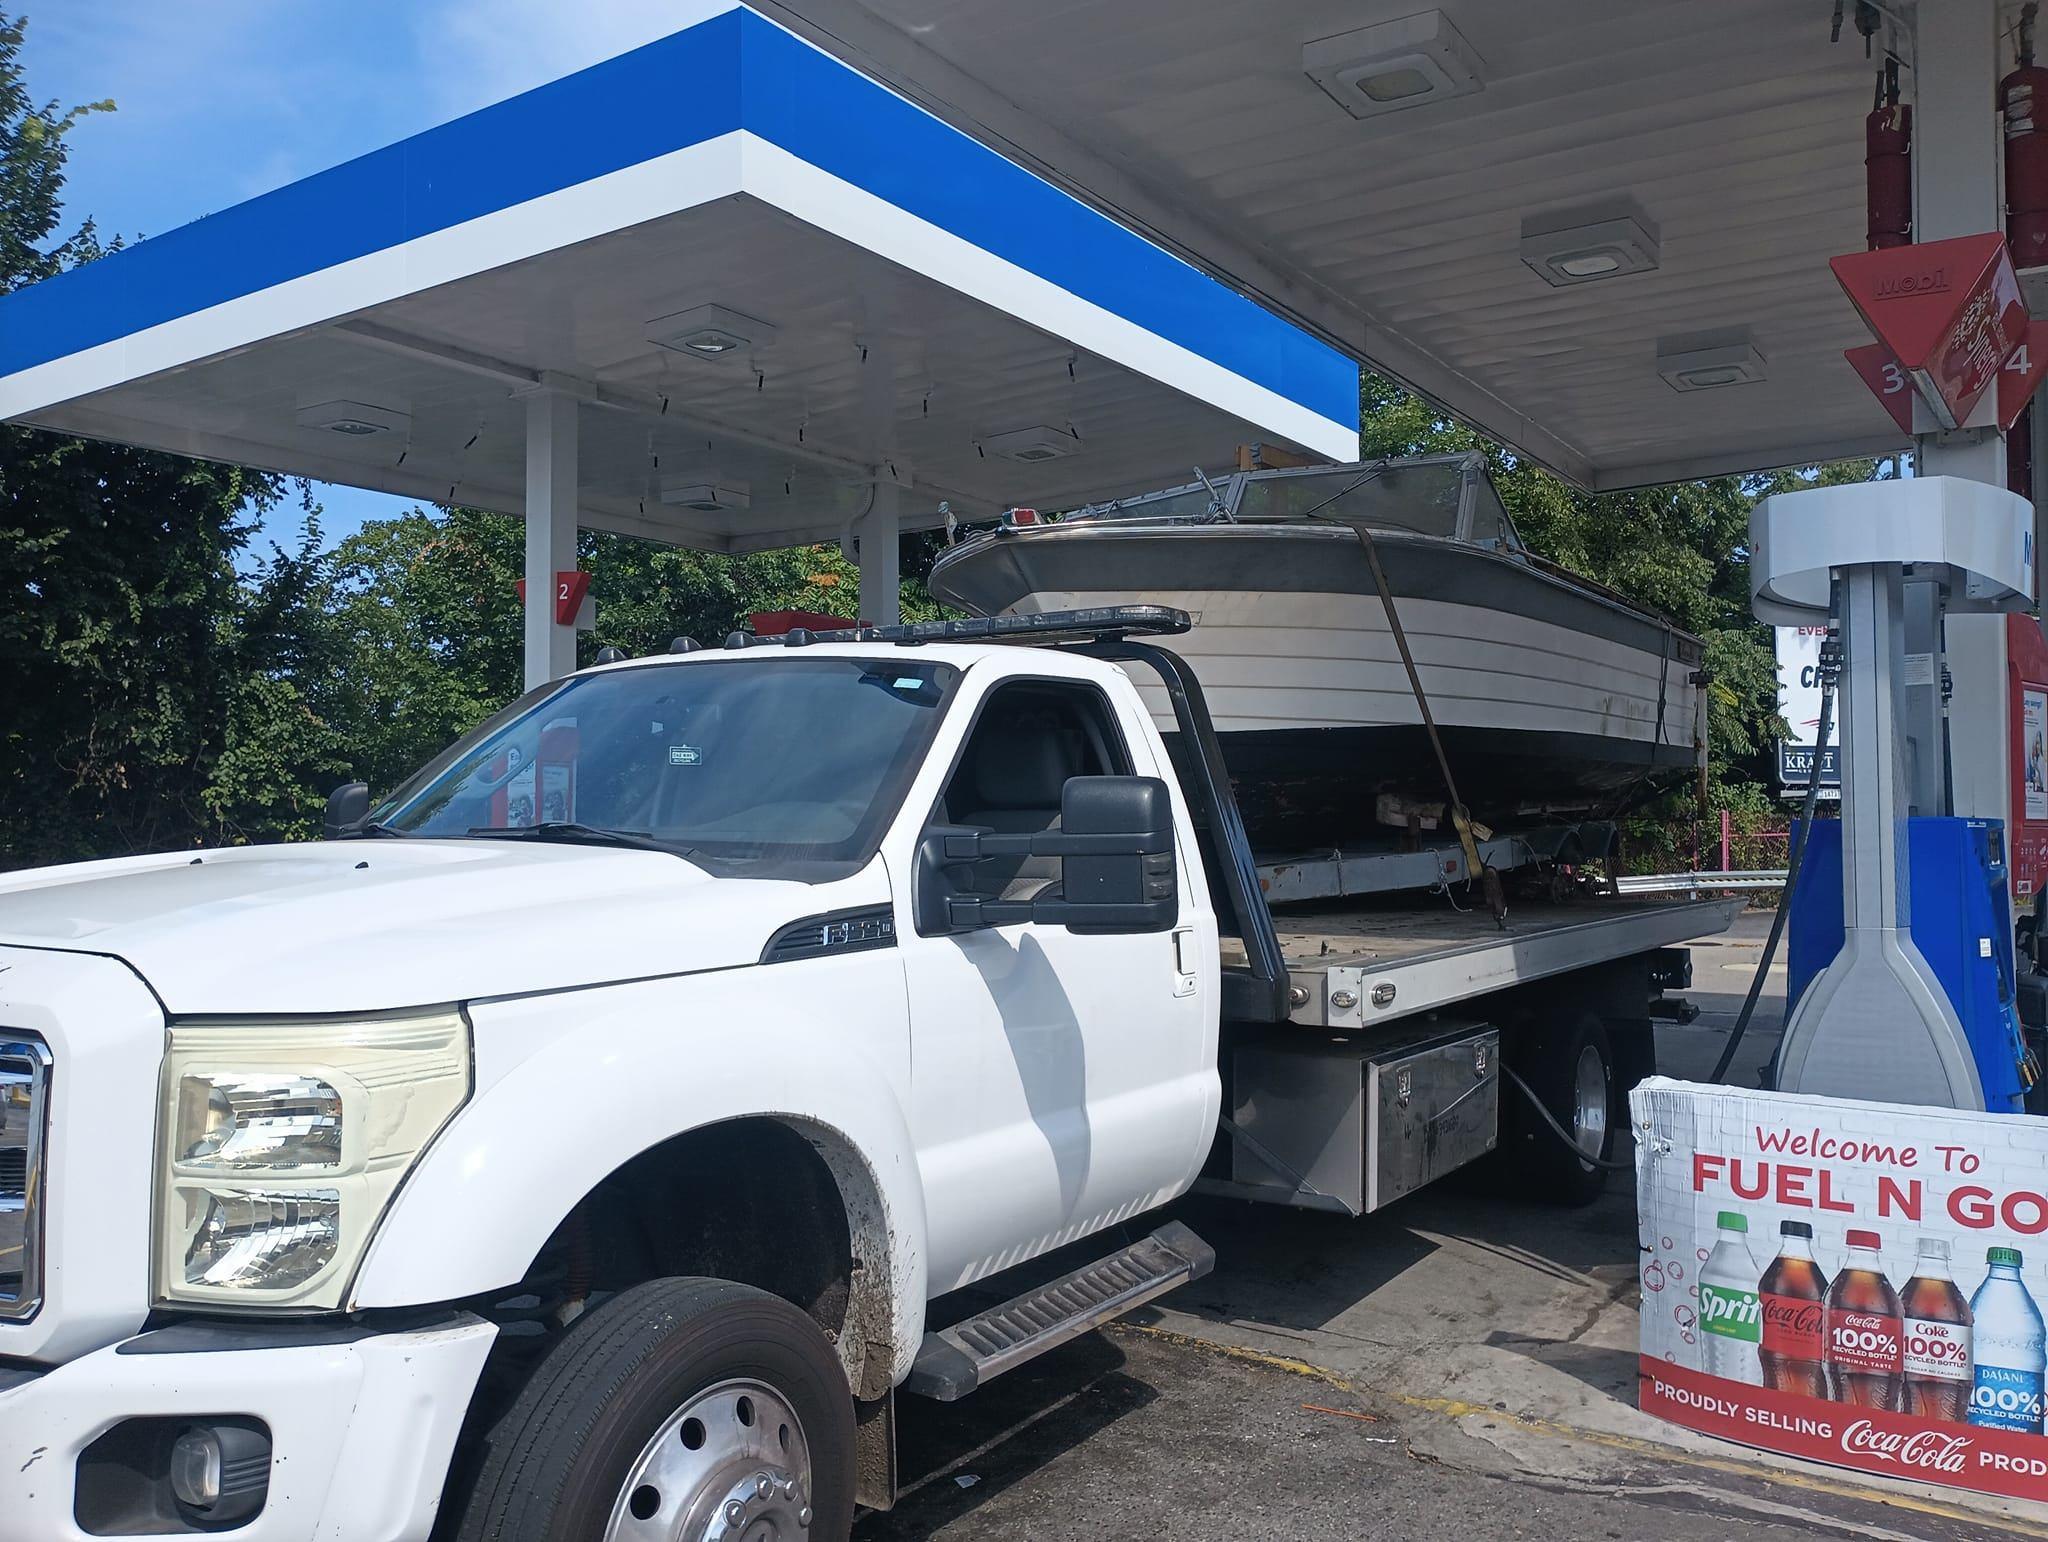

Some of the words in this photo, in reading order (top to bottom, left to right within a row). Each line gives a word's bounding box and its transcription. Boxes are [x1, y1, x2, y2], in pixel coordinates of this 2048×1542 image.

[2005, 344, 2032, 375] 4
[1882, 363, 1904, 394] 3
[559, 583, 569, 600] 2
[1785, 755, 1834, 769] KRAT
[1755, 1126, 1918, 1168] Welcome
[1934, 1146, 1980, 1174] To
[1693, 1153, 1855, 1213] FUEL
[1878, 1176, 1922, 1221] N
[1946, 1185, 2048, 1235] GO
[1700, 1287, 1761, 1324] Sprit
[1832, 1327, 1898, 1355] 100%
[1915, 1322, 1949, 1338] Coke
[1832, 1345, 1868, 1357] RECYCLED
[1903, 1335, 1967, 1361] 100%
[1904, 1355, 1937, 1365] ECYCLED
[1834, 1355, 1869, 1366] ORIGINAL
[1871, 1361, 1893, 1370] TASTE
[1982, 1369, 2024, 1383] DASANI
[1970, 1386, 2041, 1415] 100%
[1655, 1380, 1740, 1418] PROUDLY
[1745, 1407, 1833, 1438] SELLING
[1979, 1451, 2048, 1476] PROD
[1978, 1420, 2006, 1431] Purified
[2006, 1424, 2028, 1433] Water
